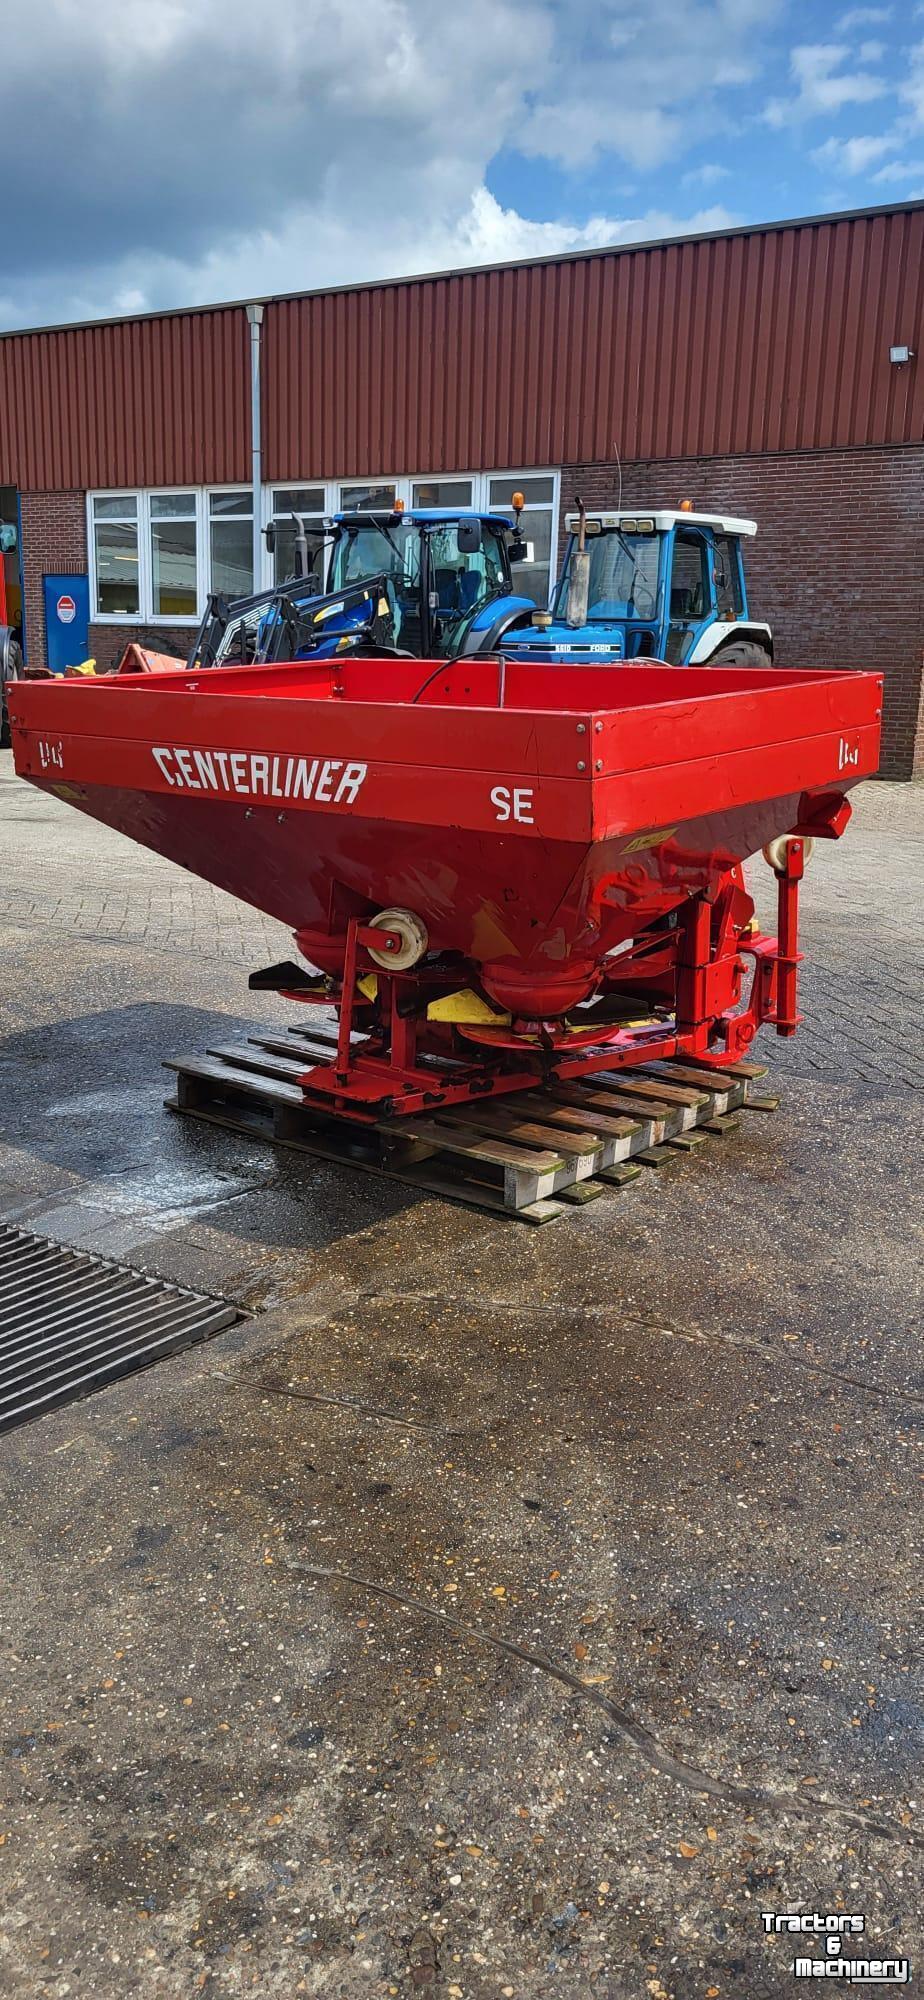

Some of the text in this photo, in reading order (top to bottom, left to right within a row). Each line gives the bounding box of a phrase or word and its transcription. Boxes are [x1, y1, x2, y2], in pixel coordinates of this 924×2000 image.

[590, 644, 611, 653] FORD
[151, 747, 368, 804] CENTERLINER
[490, 786, 534, 824] SE
